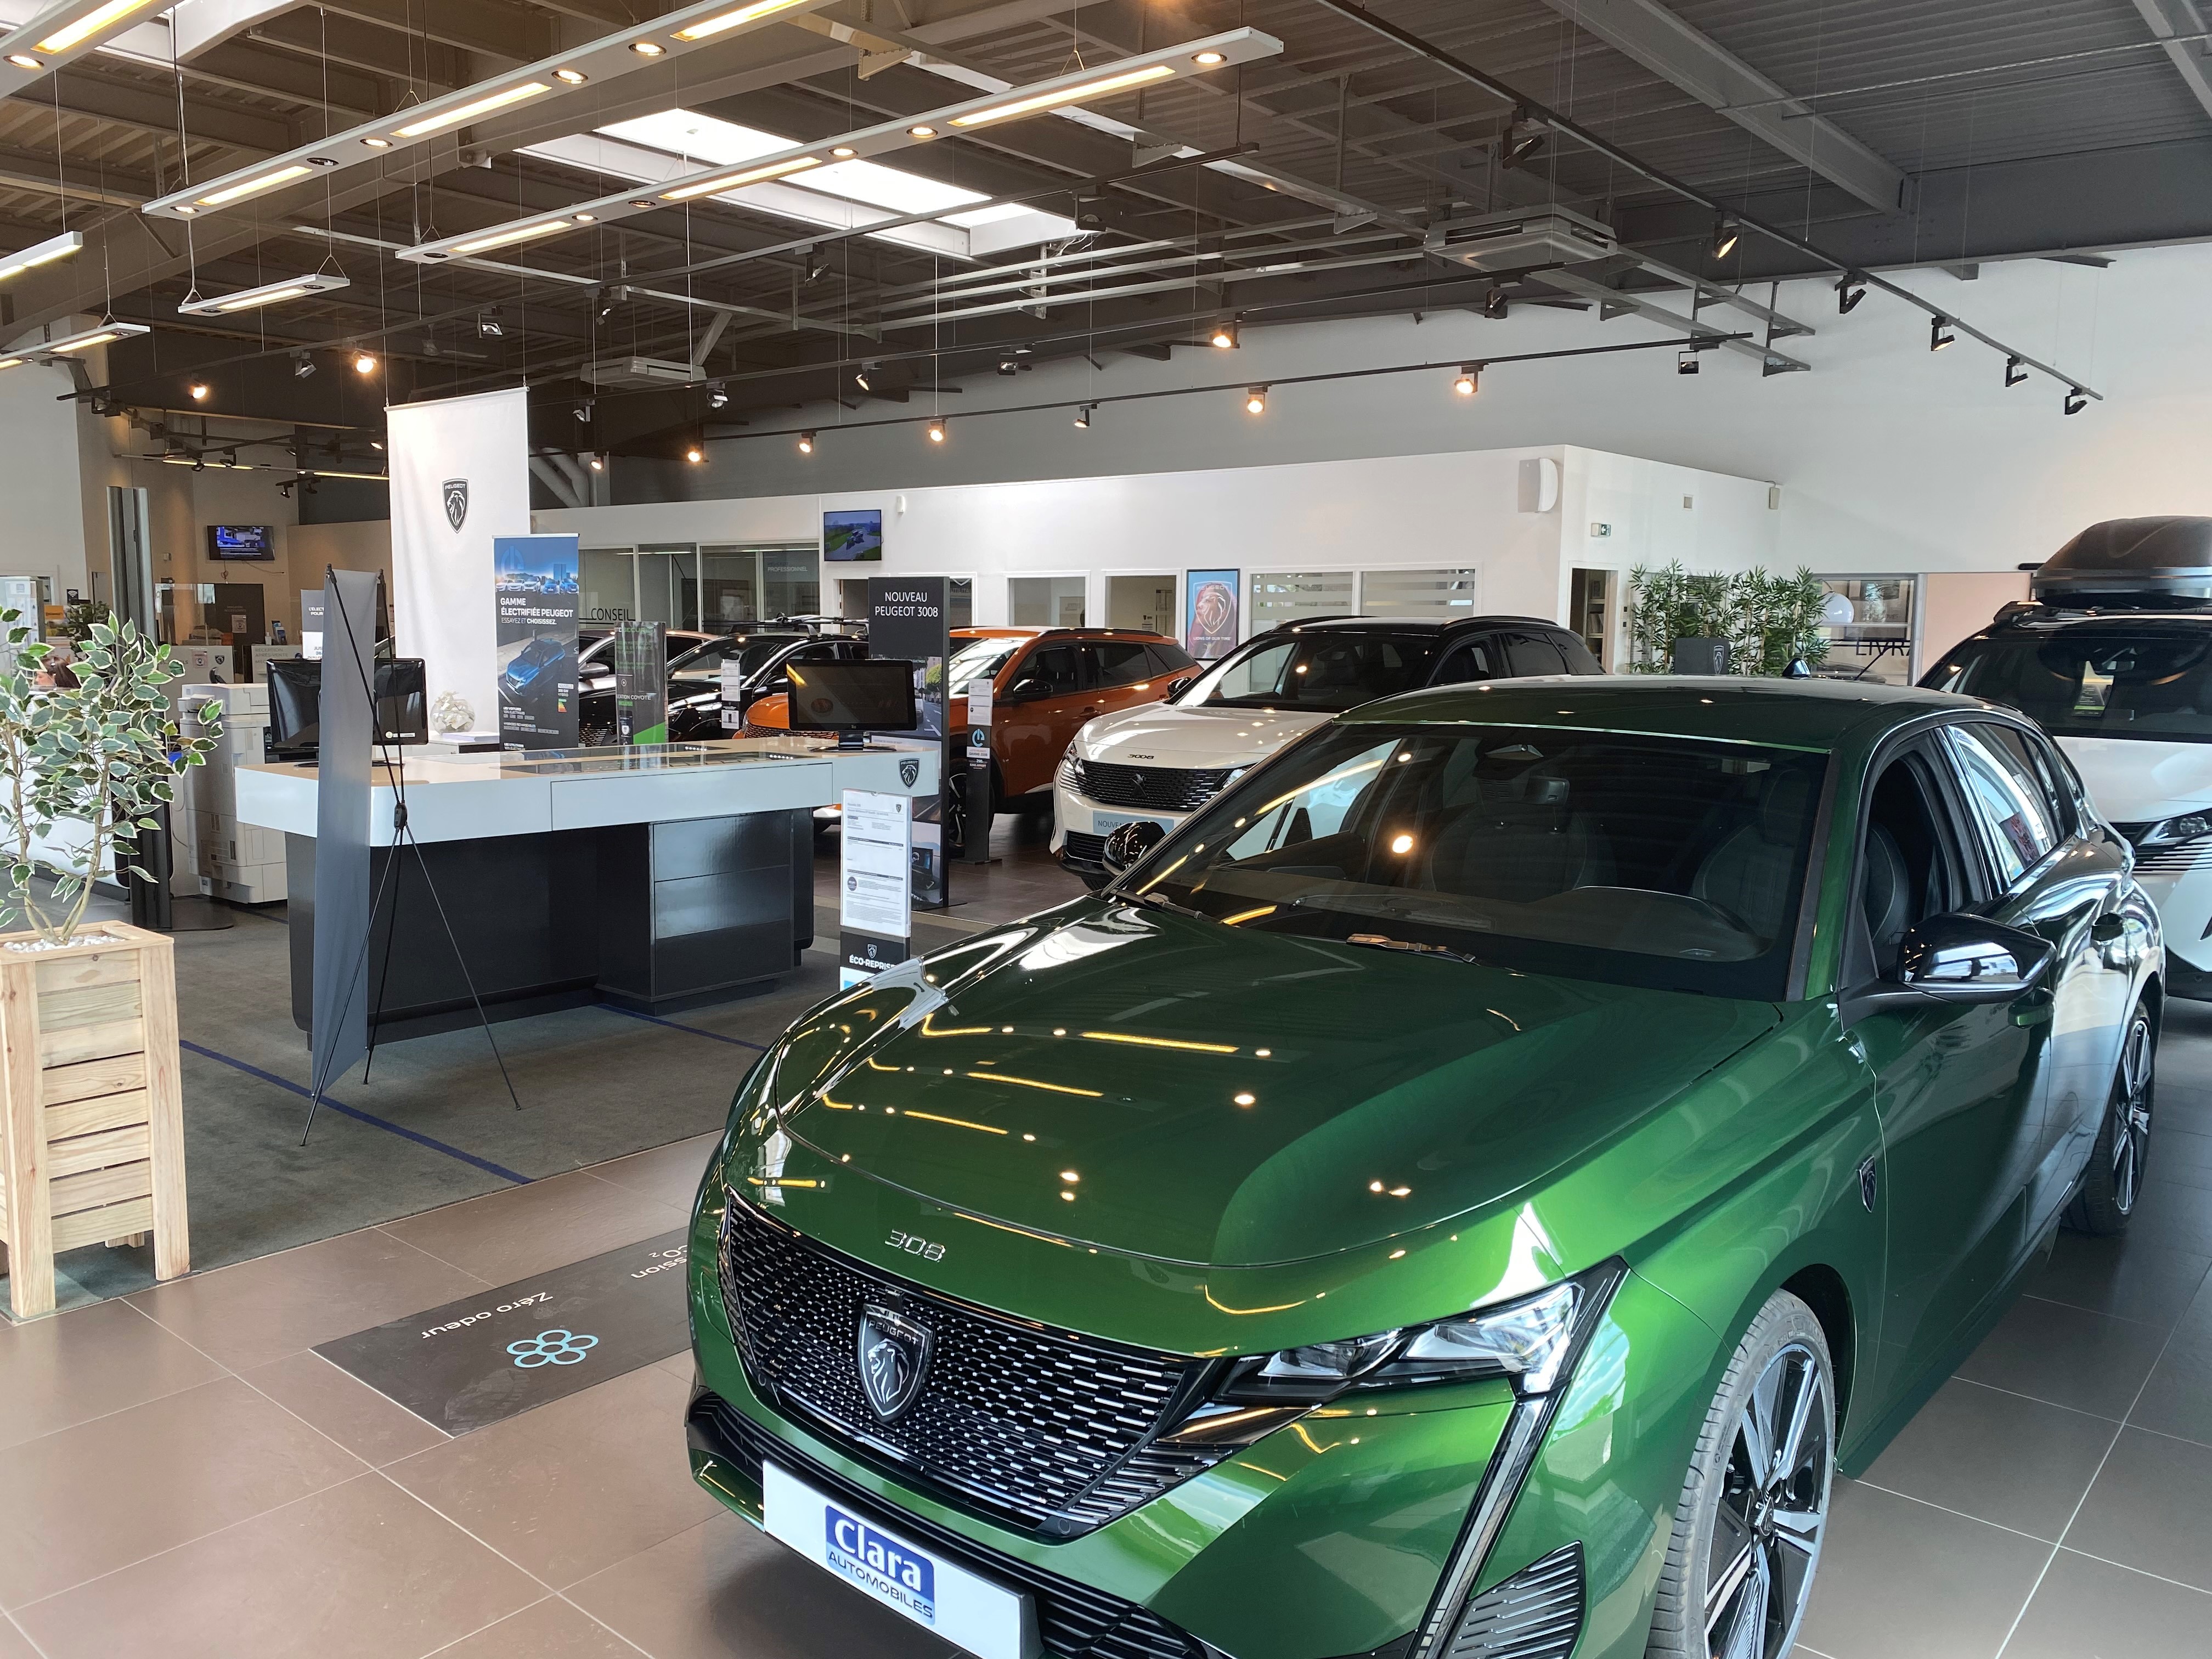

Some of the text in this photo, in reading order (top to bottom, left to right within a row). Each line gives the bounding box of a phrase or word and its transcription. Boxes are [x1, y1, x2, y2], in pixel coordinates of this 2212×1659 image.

[500, 597, 526, 606] GAMME
[885, 592, 928, 602] NOUVEAU
[500, 606, 574, 617] ÉLECTRIFIÉE PEUGEOT
[591, 608, 631, 622] CONSEIL
[875, 606, 939, 617] PEUGEOT 3008
[884, 1229, 946, 1262] 308
[421, 1291, 554, 1339] Zéro odeur
[868, 1319, 919, 1345] PEUGEOT
[834, 1518, 922, 1592] Clara
[828, 1550, 933, 1619] AUTOMOBILES
